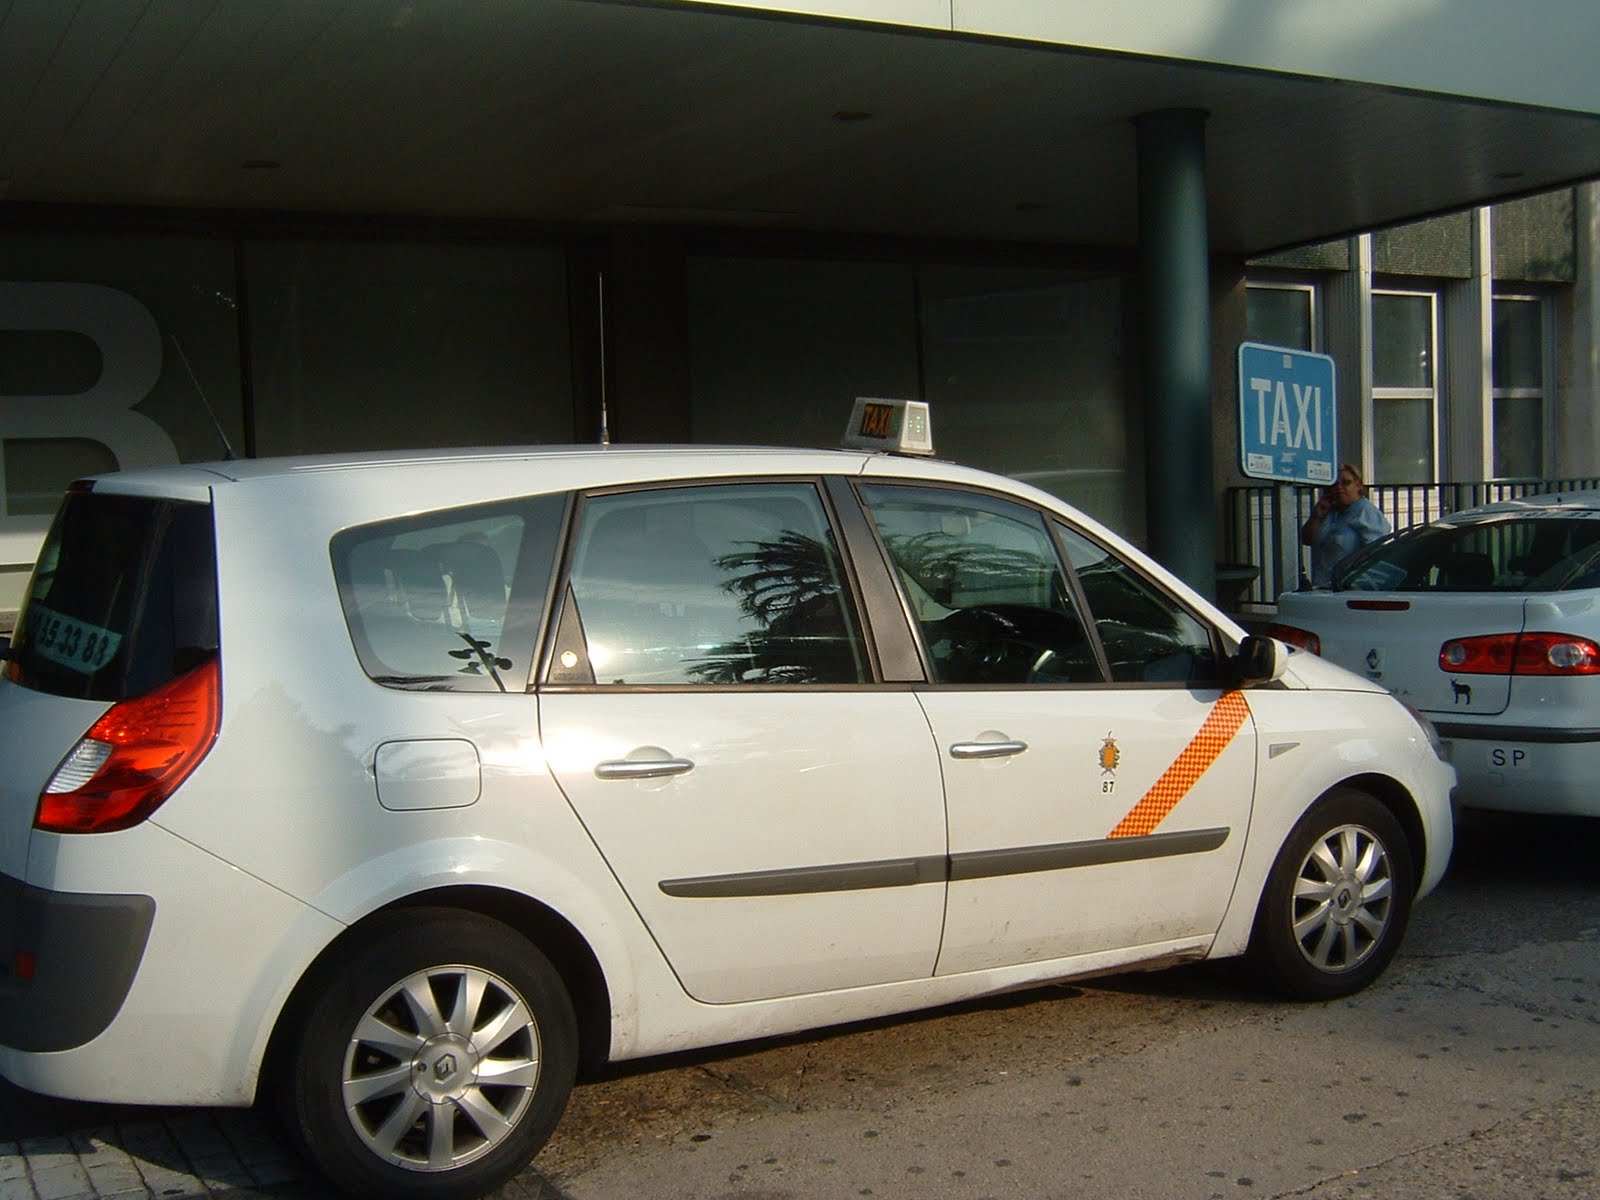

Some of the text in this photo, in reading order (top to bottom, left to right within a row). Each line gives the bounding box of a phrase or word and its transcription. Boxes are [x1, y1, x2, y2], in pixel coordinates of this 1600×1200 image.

[863, 405, 894, 436] TAXI
[1251, 377, 1322, 451] TAXI
[1102, 781, 1114, 793] 87
